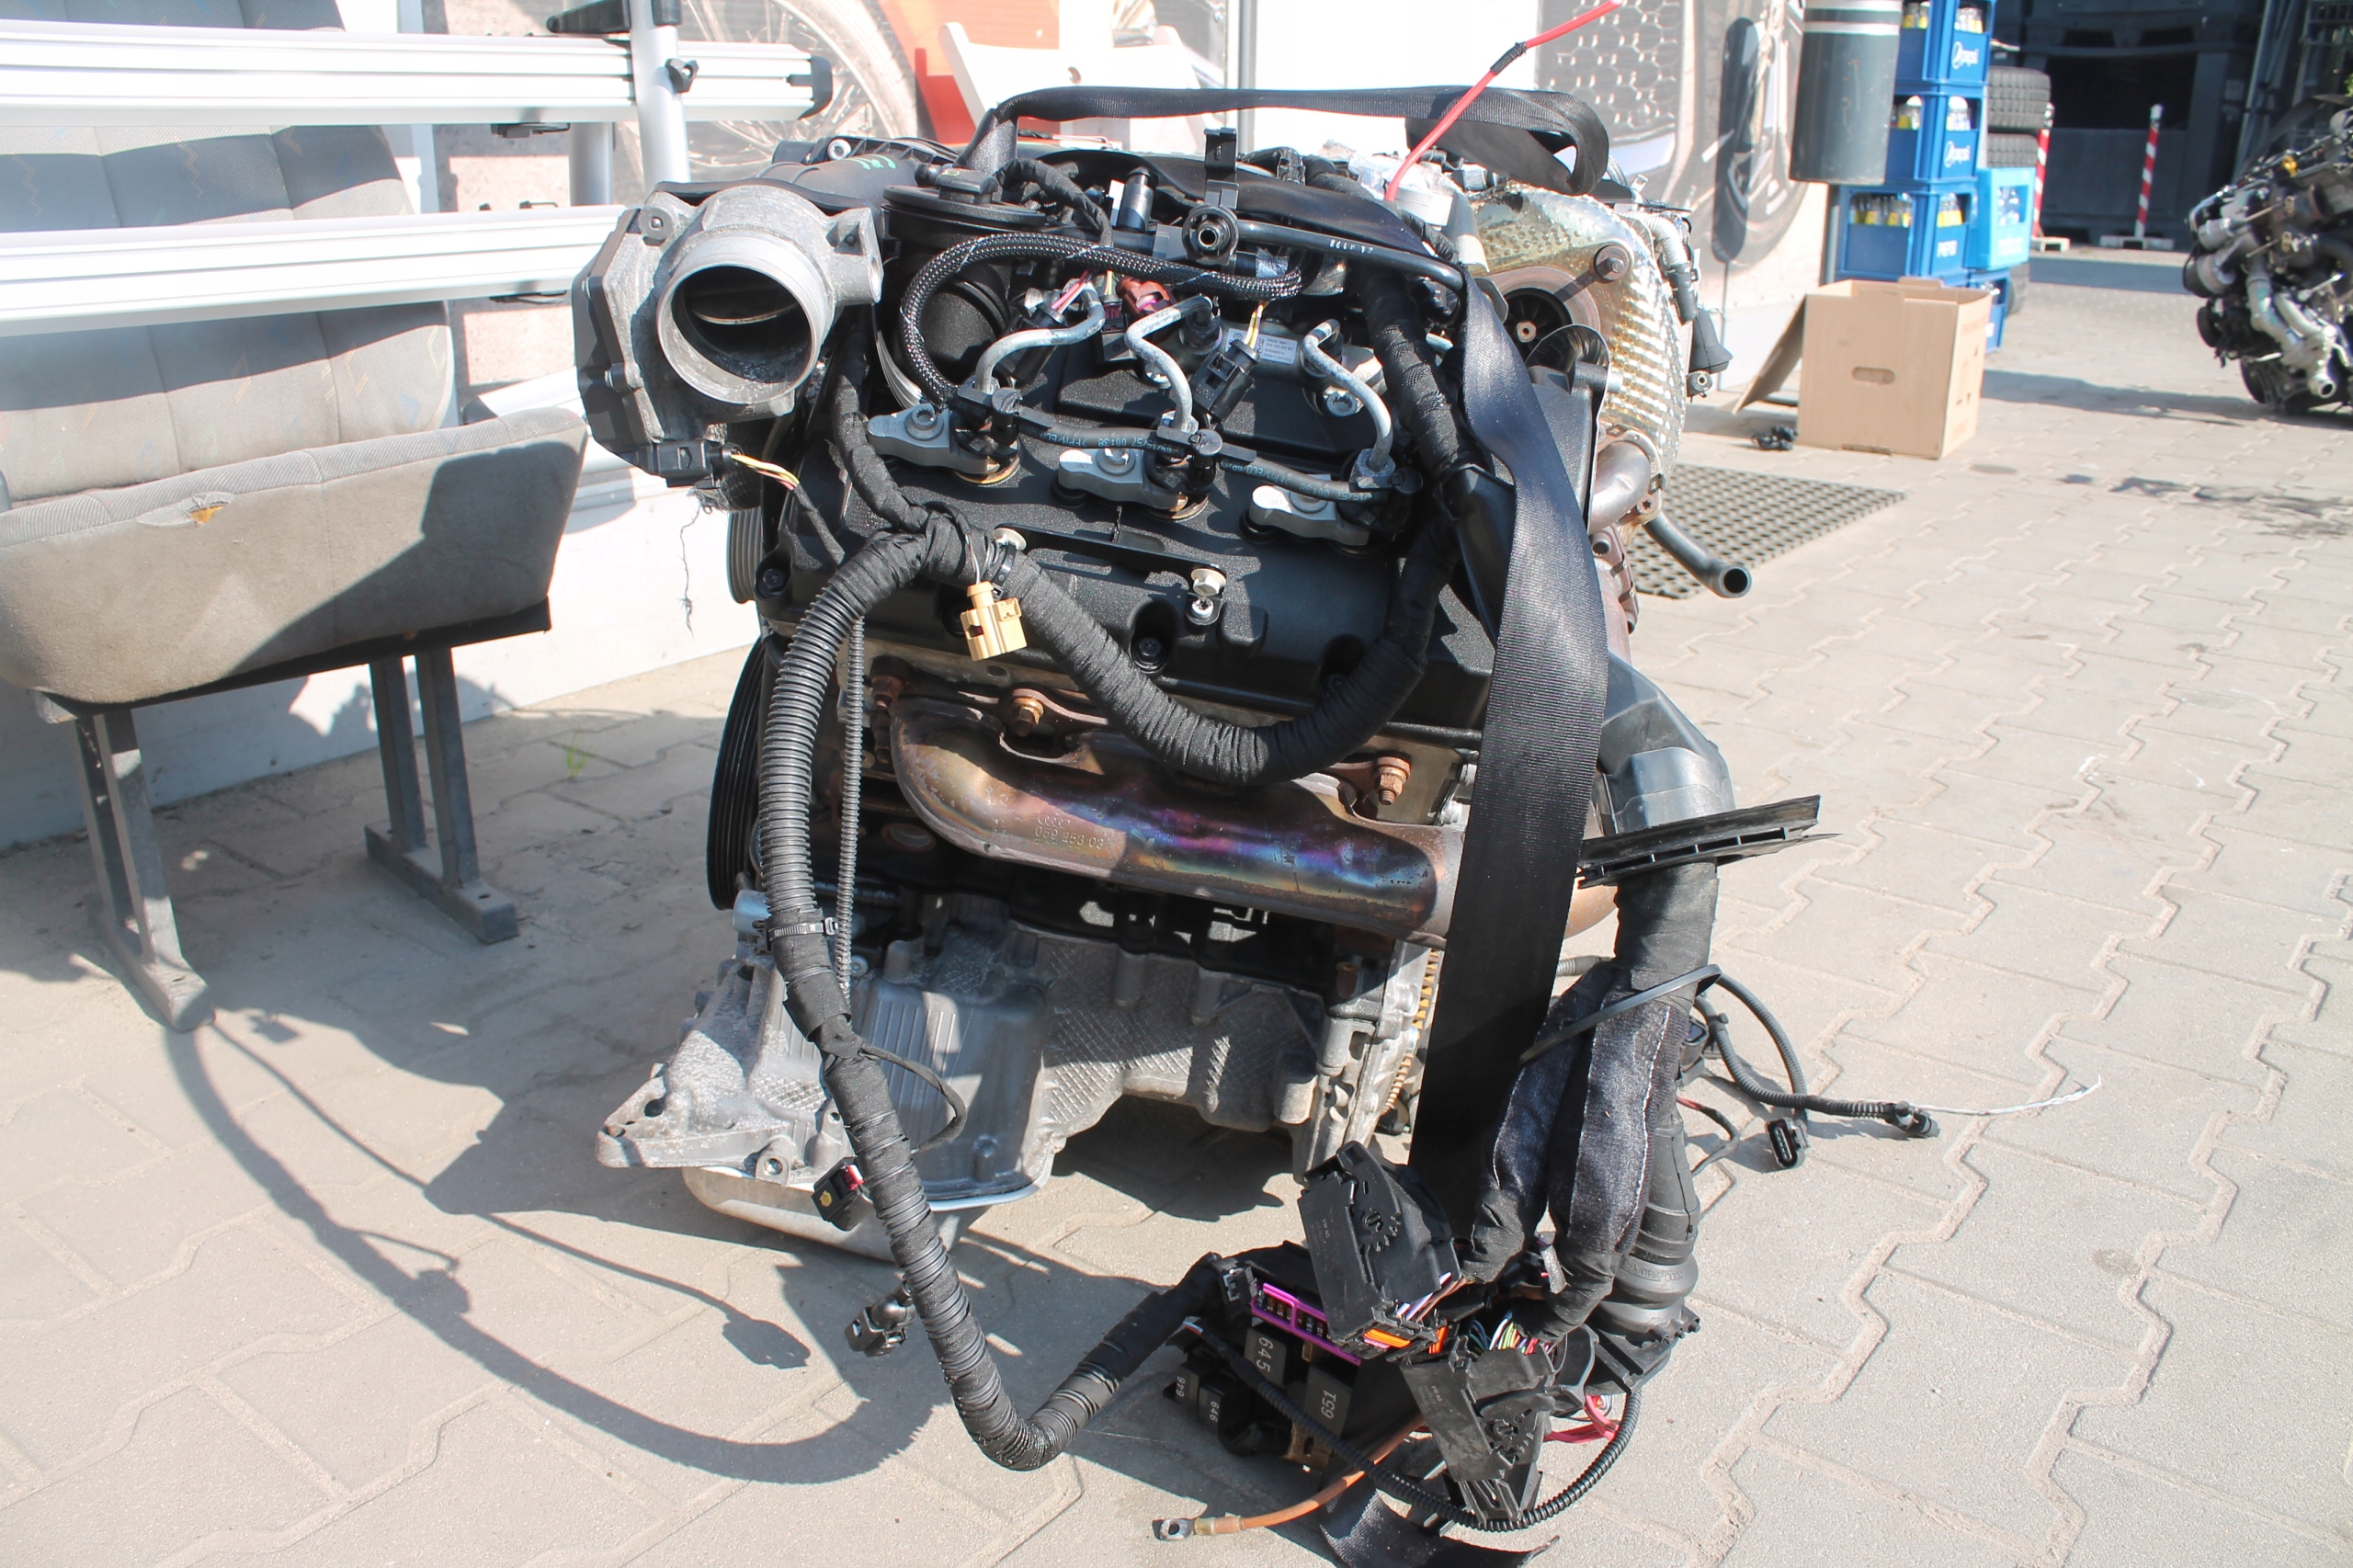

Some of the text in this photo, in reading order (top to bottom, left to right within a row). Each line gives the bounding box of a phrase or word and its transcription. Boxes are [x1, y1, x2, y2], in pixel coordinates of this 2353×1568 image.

[1097, 437, 1127, 447] 00:38
[1035, 826, 1059, 840] 059
[1062, 832, 1085, 846] 253
[1256, 1336, 1274, 1372] 645
[1176, 1376, 1186, 1397] 646
[1209, 1401, 1220, 1423] 646
[1321, 1389, 1336, 1419] 651
